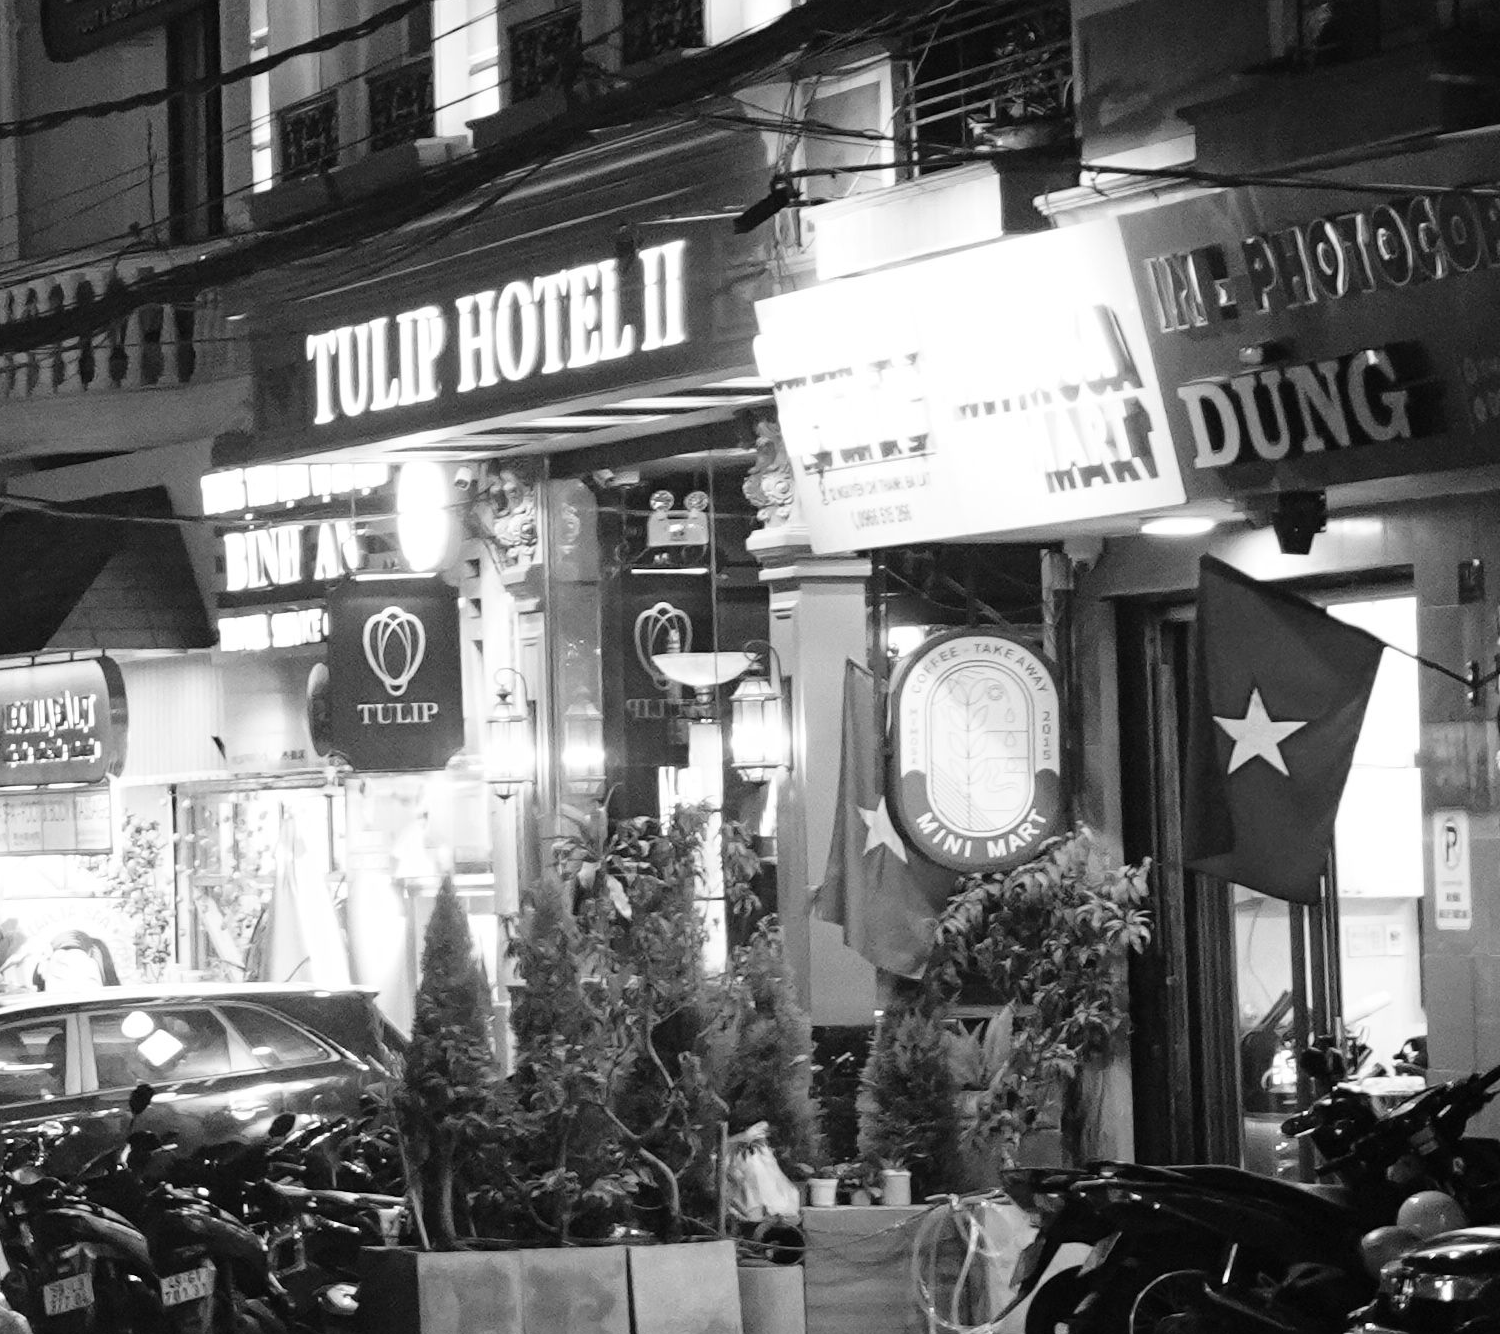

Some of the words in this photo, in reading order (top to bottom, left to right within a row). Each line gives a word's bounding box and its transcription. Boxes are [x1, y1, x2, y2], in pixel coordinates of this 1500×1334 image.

[306, 304, 446, 425] TULIP
[454, 258, 633, 393] HOTEL
[638, 239, 686, 352] II
[912, 645, 960, 694] COFFEE
[357, 702, 439, 725] TULIP
[916, 811, 972, 858] MINI
[987, 808, 1047, 858] MART
